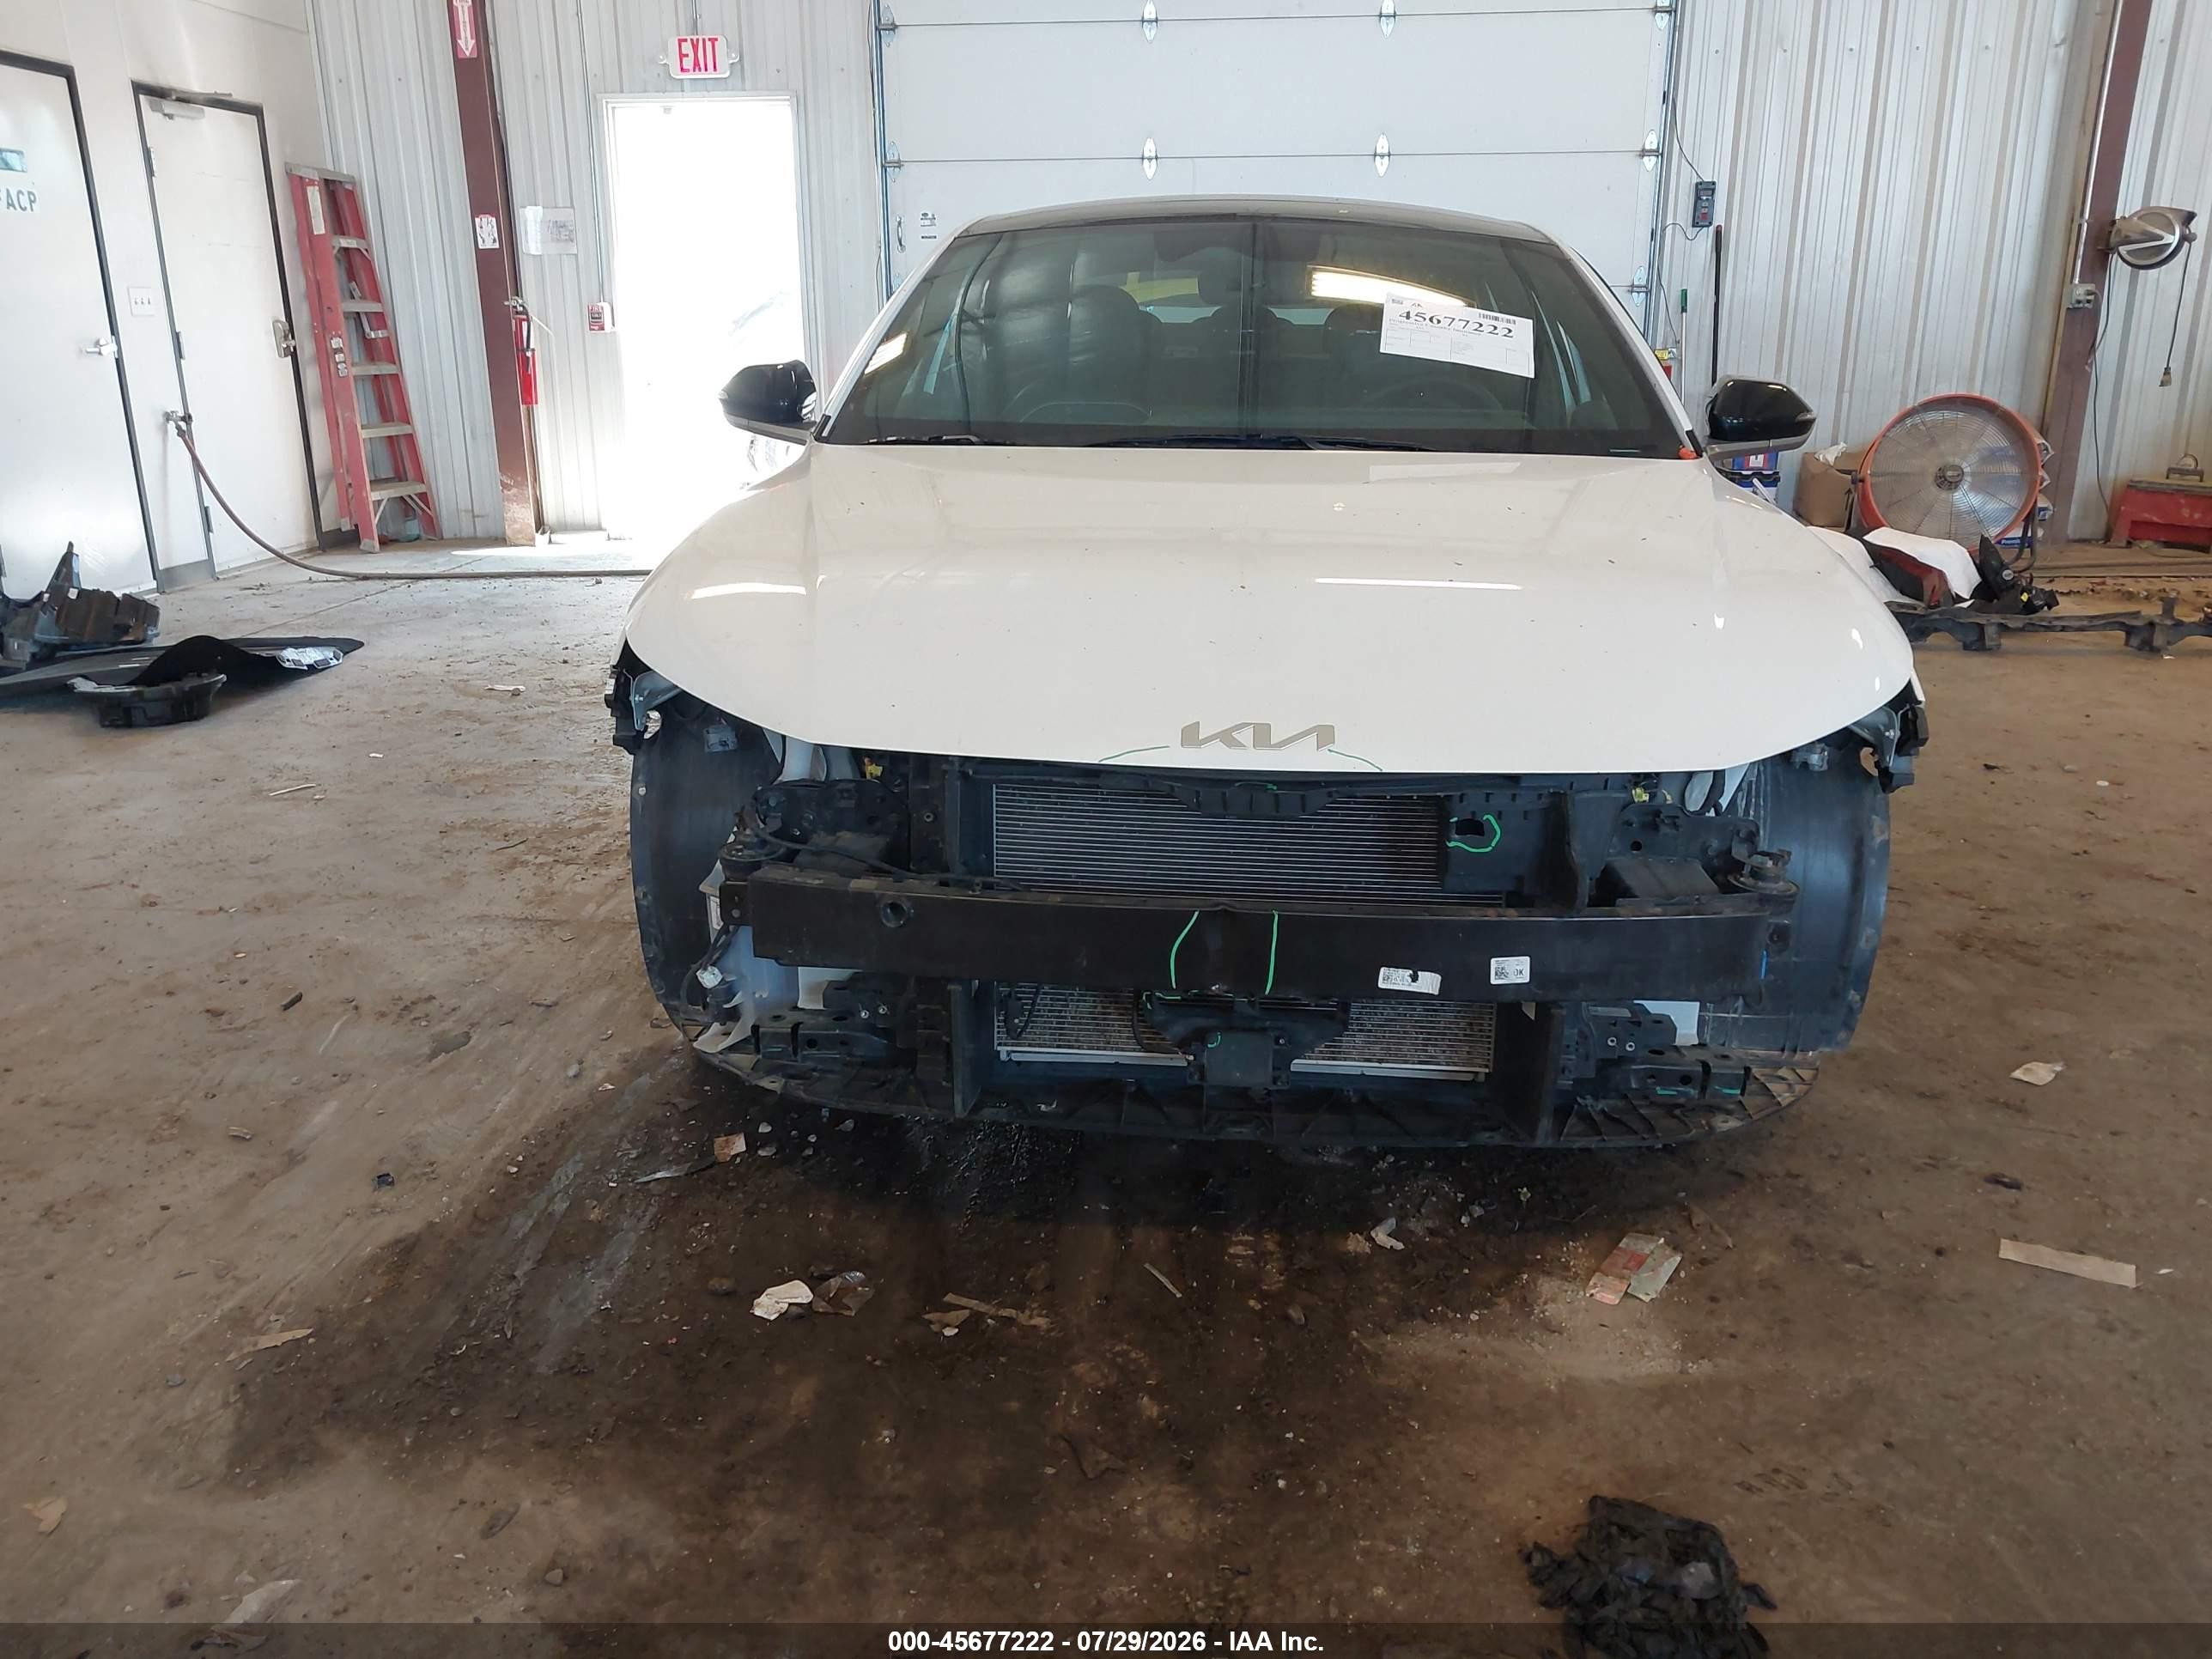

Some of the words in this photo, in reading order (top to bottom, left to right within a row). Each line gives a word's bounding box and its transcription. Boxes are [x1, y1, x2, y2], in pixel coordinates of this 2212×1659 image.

[678, 37, 719, 72] EXIT
[0, 188, 37, 212] ACP
[1399, 309, 1514, 338] 45677222
[1182, 721, 1335, 751] KIA
